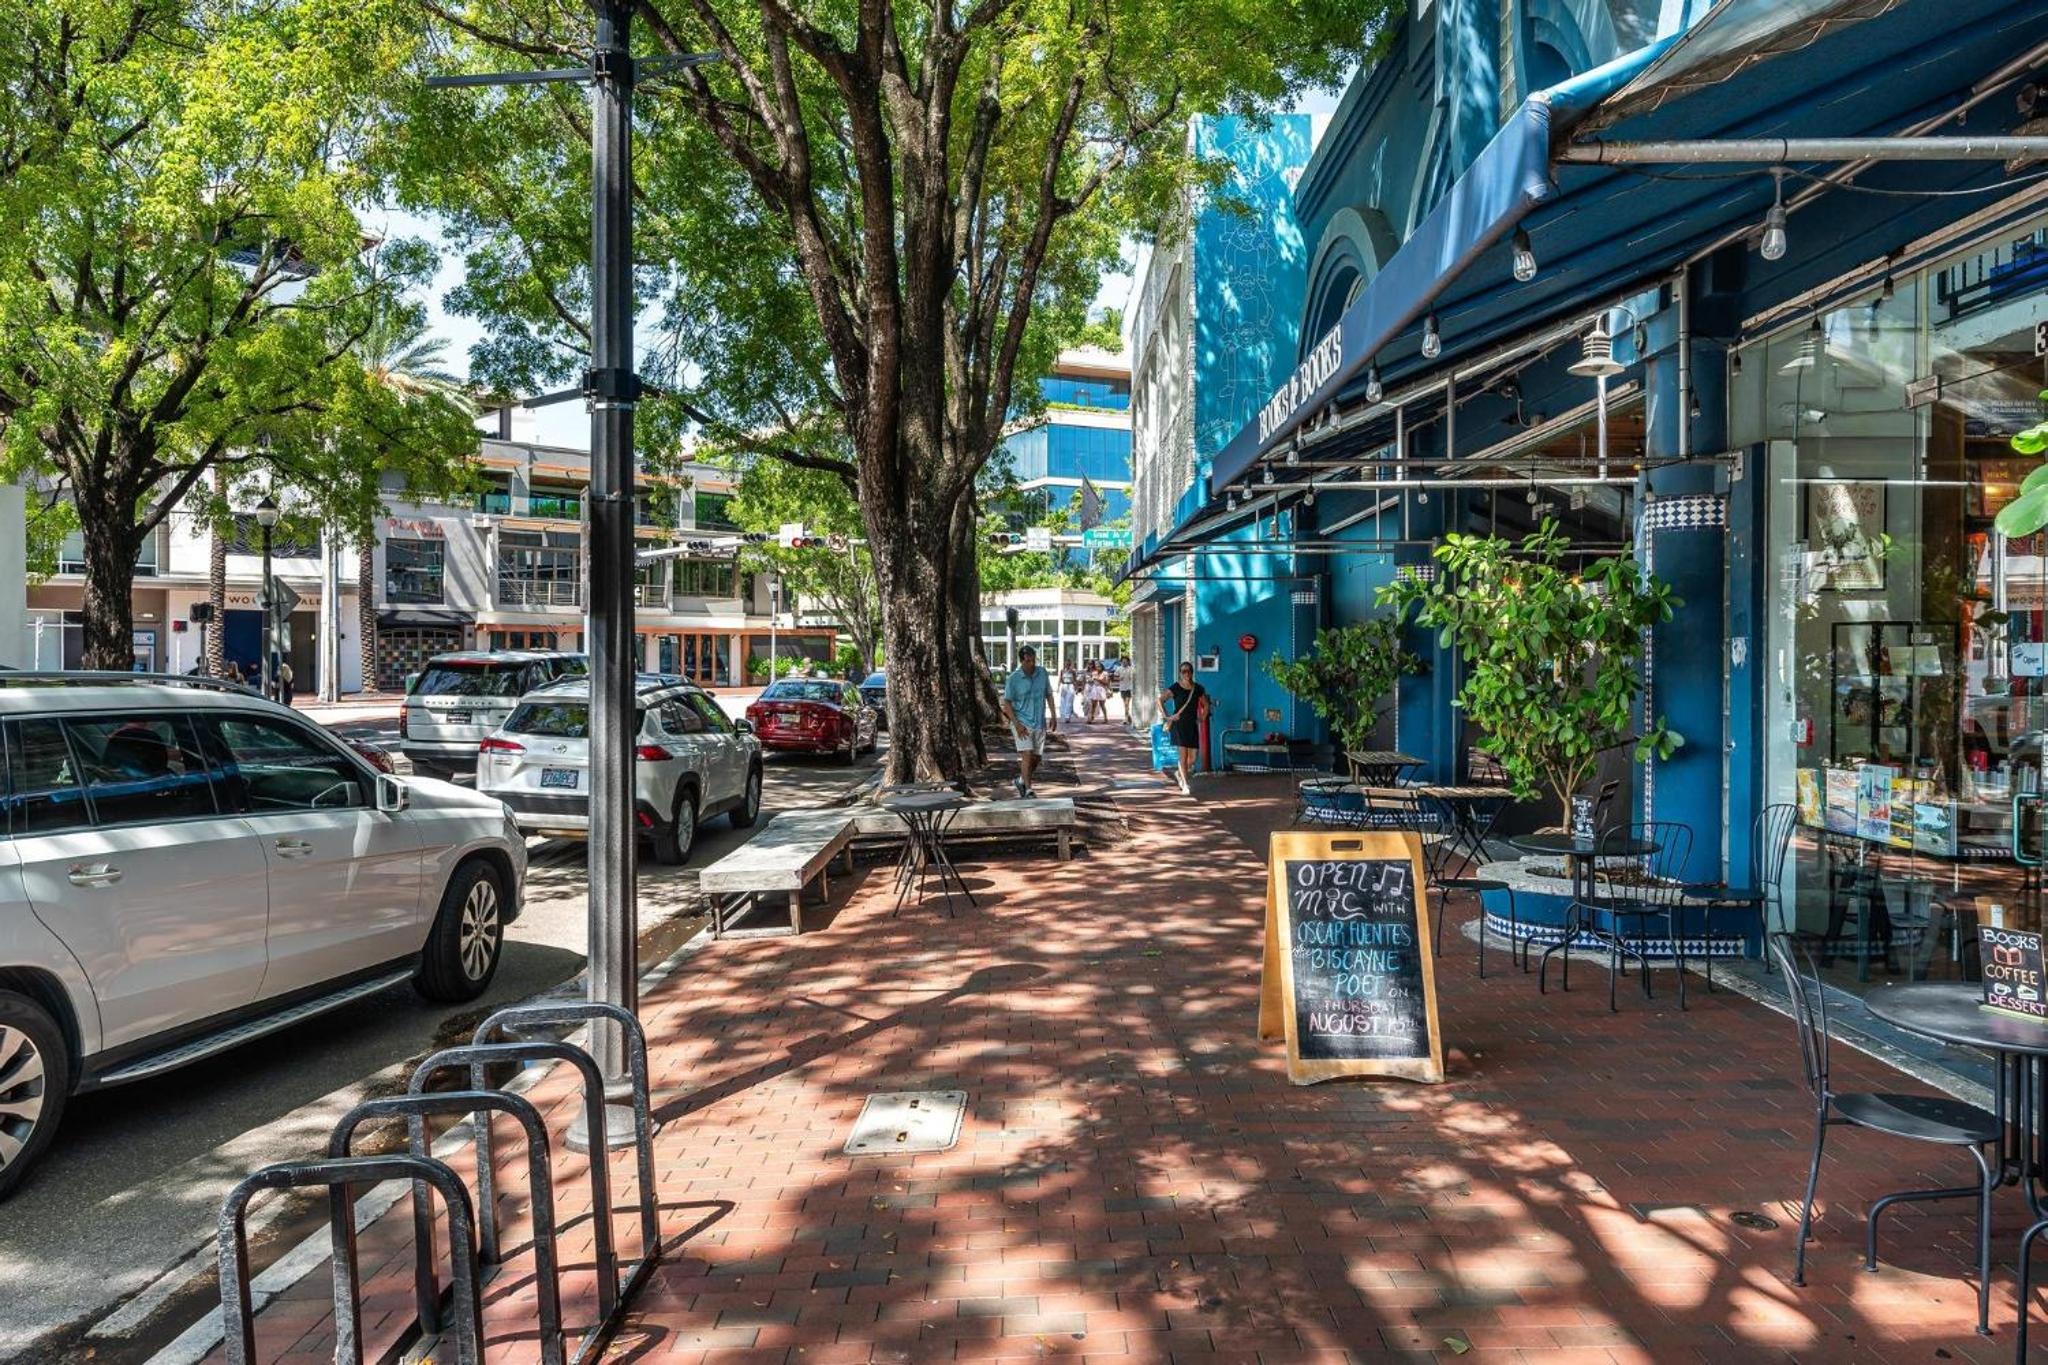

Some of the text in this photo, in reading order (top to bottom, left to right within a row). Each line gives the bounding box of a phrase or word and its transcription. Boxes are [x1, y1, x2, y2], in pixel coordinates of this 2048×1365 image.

[1259, 323, 1342, 444] BOOKS & BOOKS
[1298, 863, 1367, 891] OPEN
[1373, 901, 1406, 914] WITH
[1298, 921, 1411, 947] OSCAR FUENTES
[1982, 928, 2039, 951] BOOKS
[1311, 948, 1400, 971] BISCAYNE
[1330, 973, 1409, 998] POET ON
[1985, 963, 2039, 986] COFFEE
[1324, 1000, 1396, 1014] THURSDAY
[1988, 993, 2047, 1016] DESSERT
[1309, 1012, 1382, 1034] AUGUST
